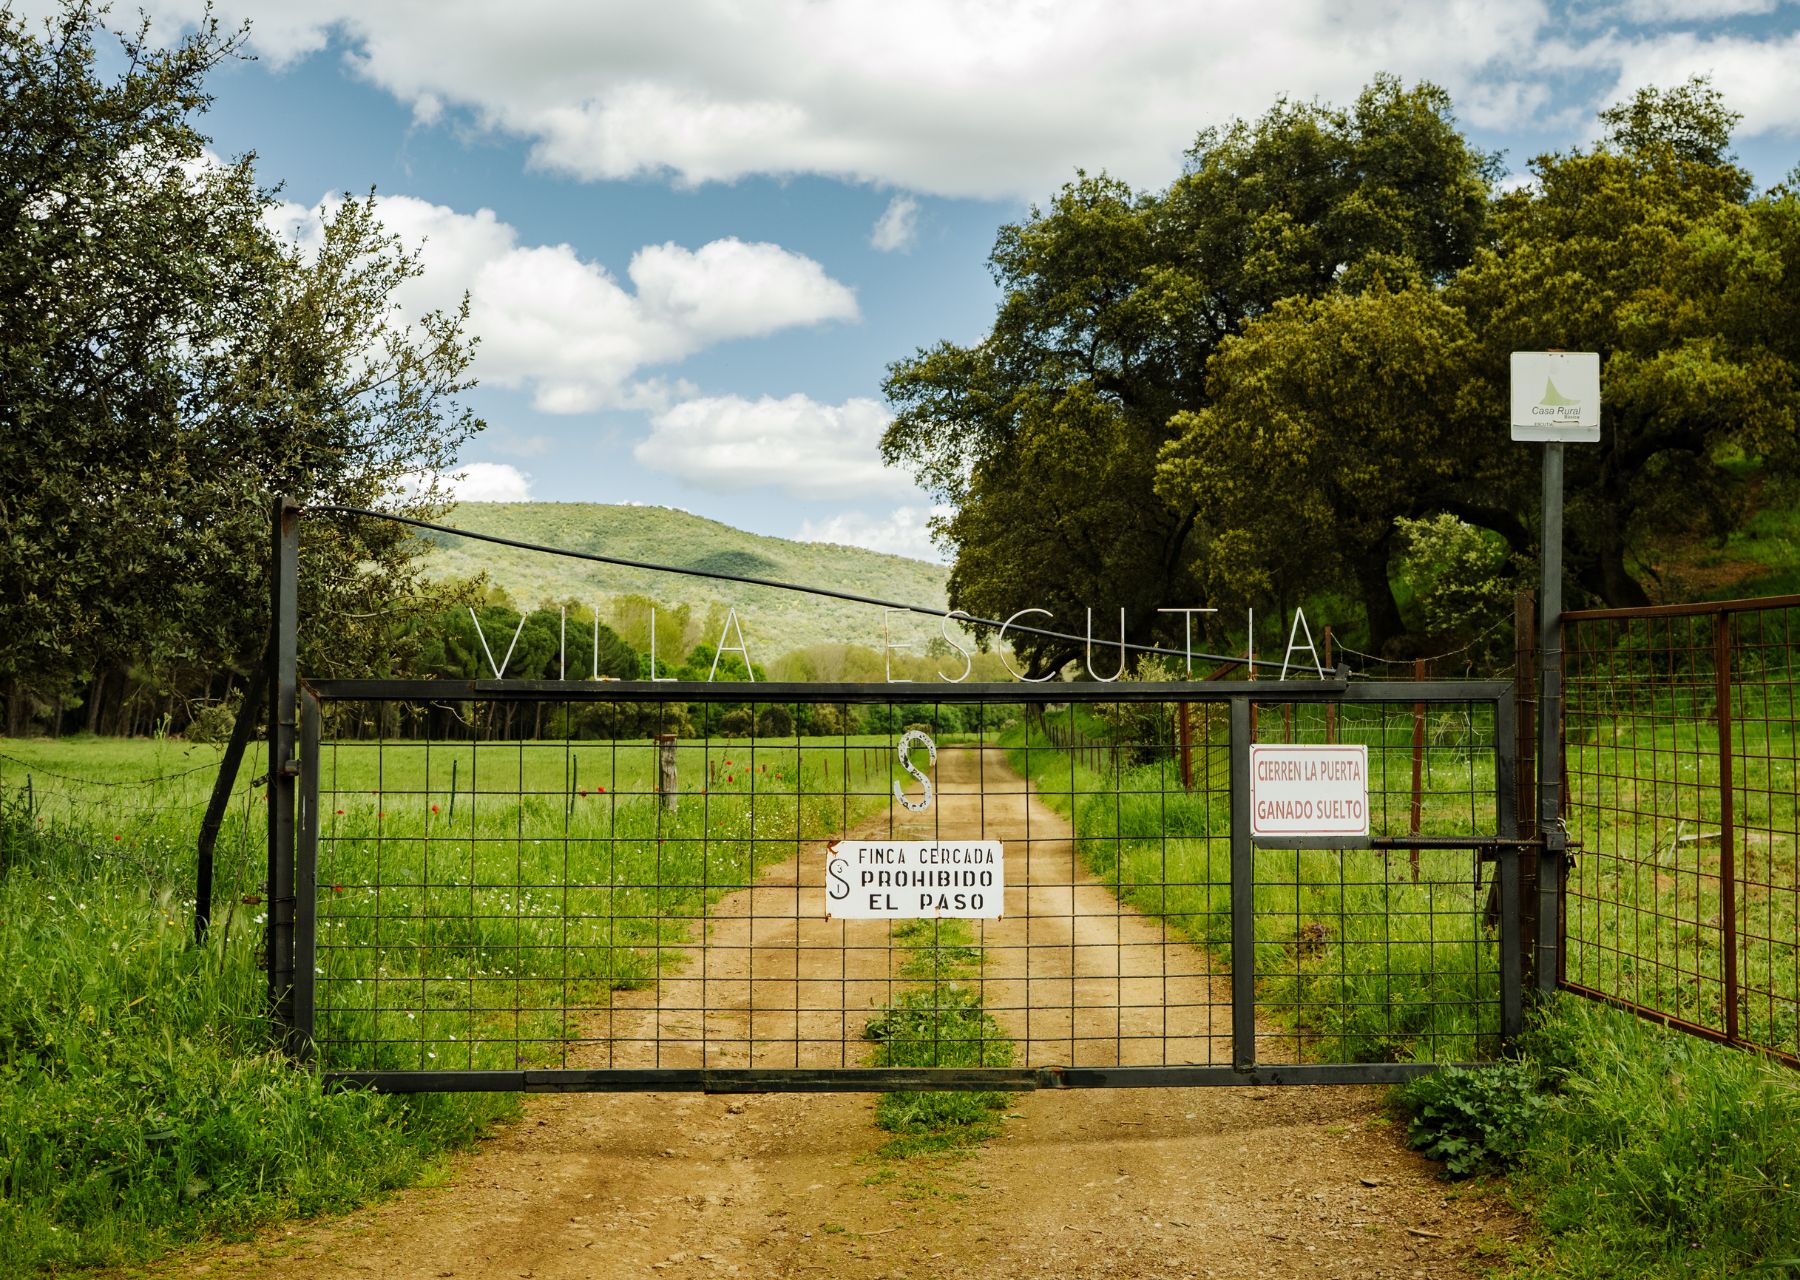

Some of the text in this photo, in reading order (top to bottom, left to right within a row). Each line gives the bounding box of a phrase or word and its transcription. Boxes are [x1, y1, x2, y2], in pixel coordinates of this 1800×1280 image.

[1532, 406, 1581, 415] Casa Rural
[469, 606, 1325, 683] VILLA ESCUTIA
[1258, 760, 1361, 781] CIERREN LA PUERTA
[1258, 800, 1362, 820] GANADO SUELTO
[859, 848, 994, 865] FINCA CERCADA
[861, 870, 993, 888] PROHIBIDO
[869, 893, 984, 911] EL PASO
